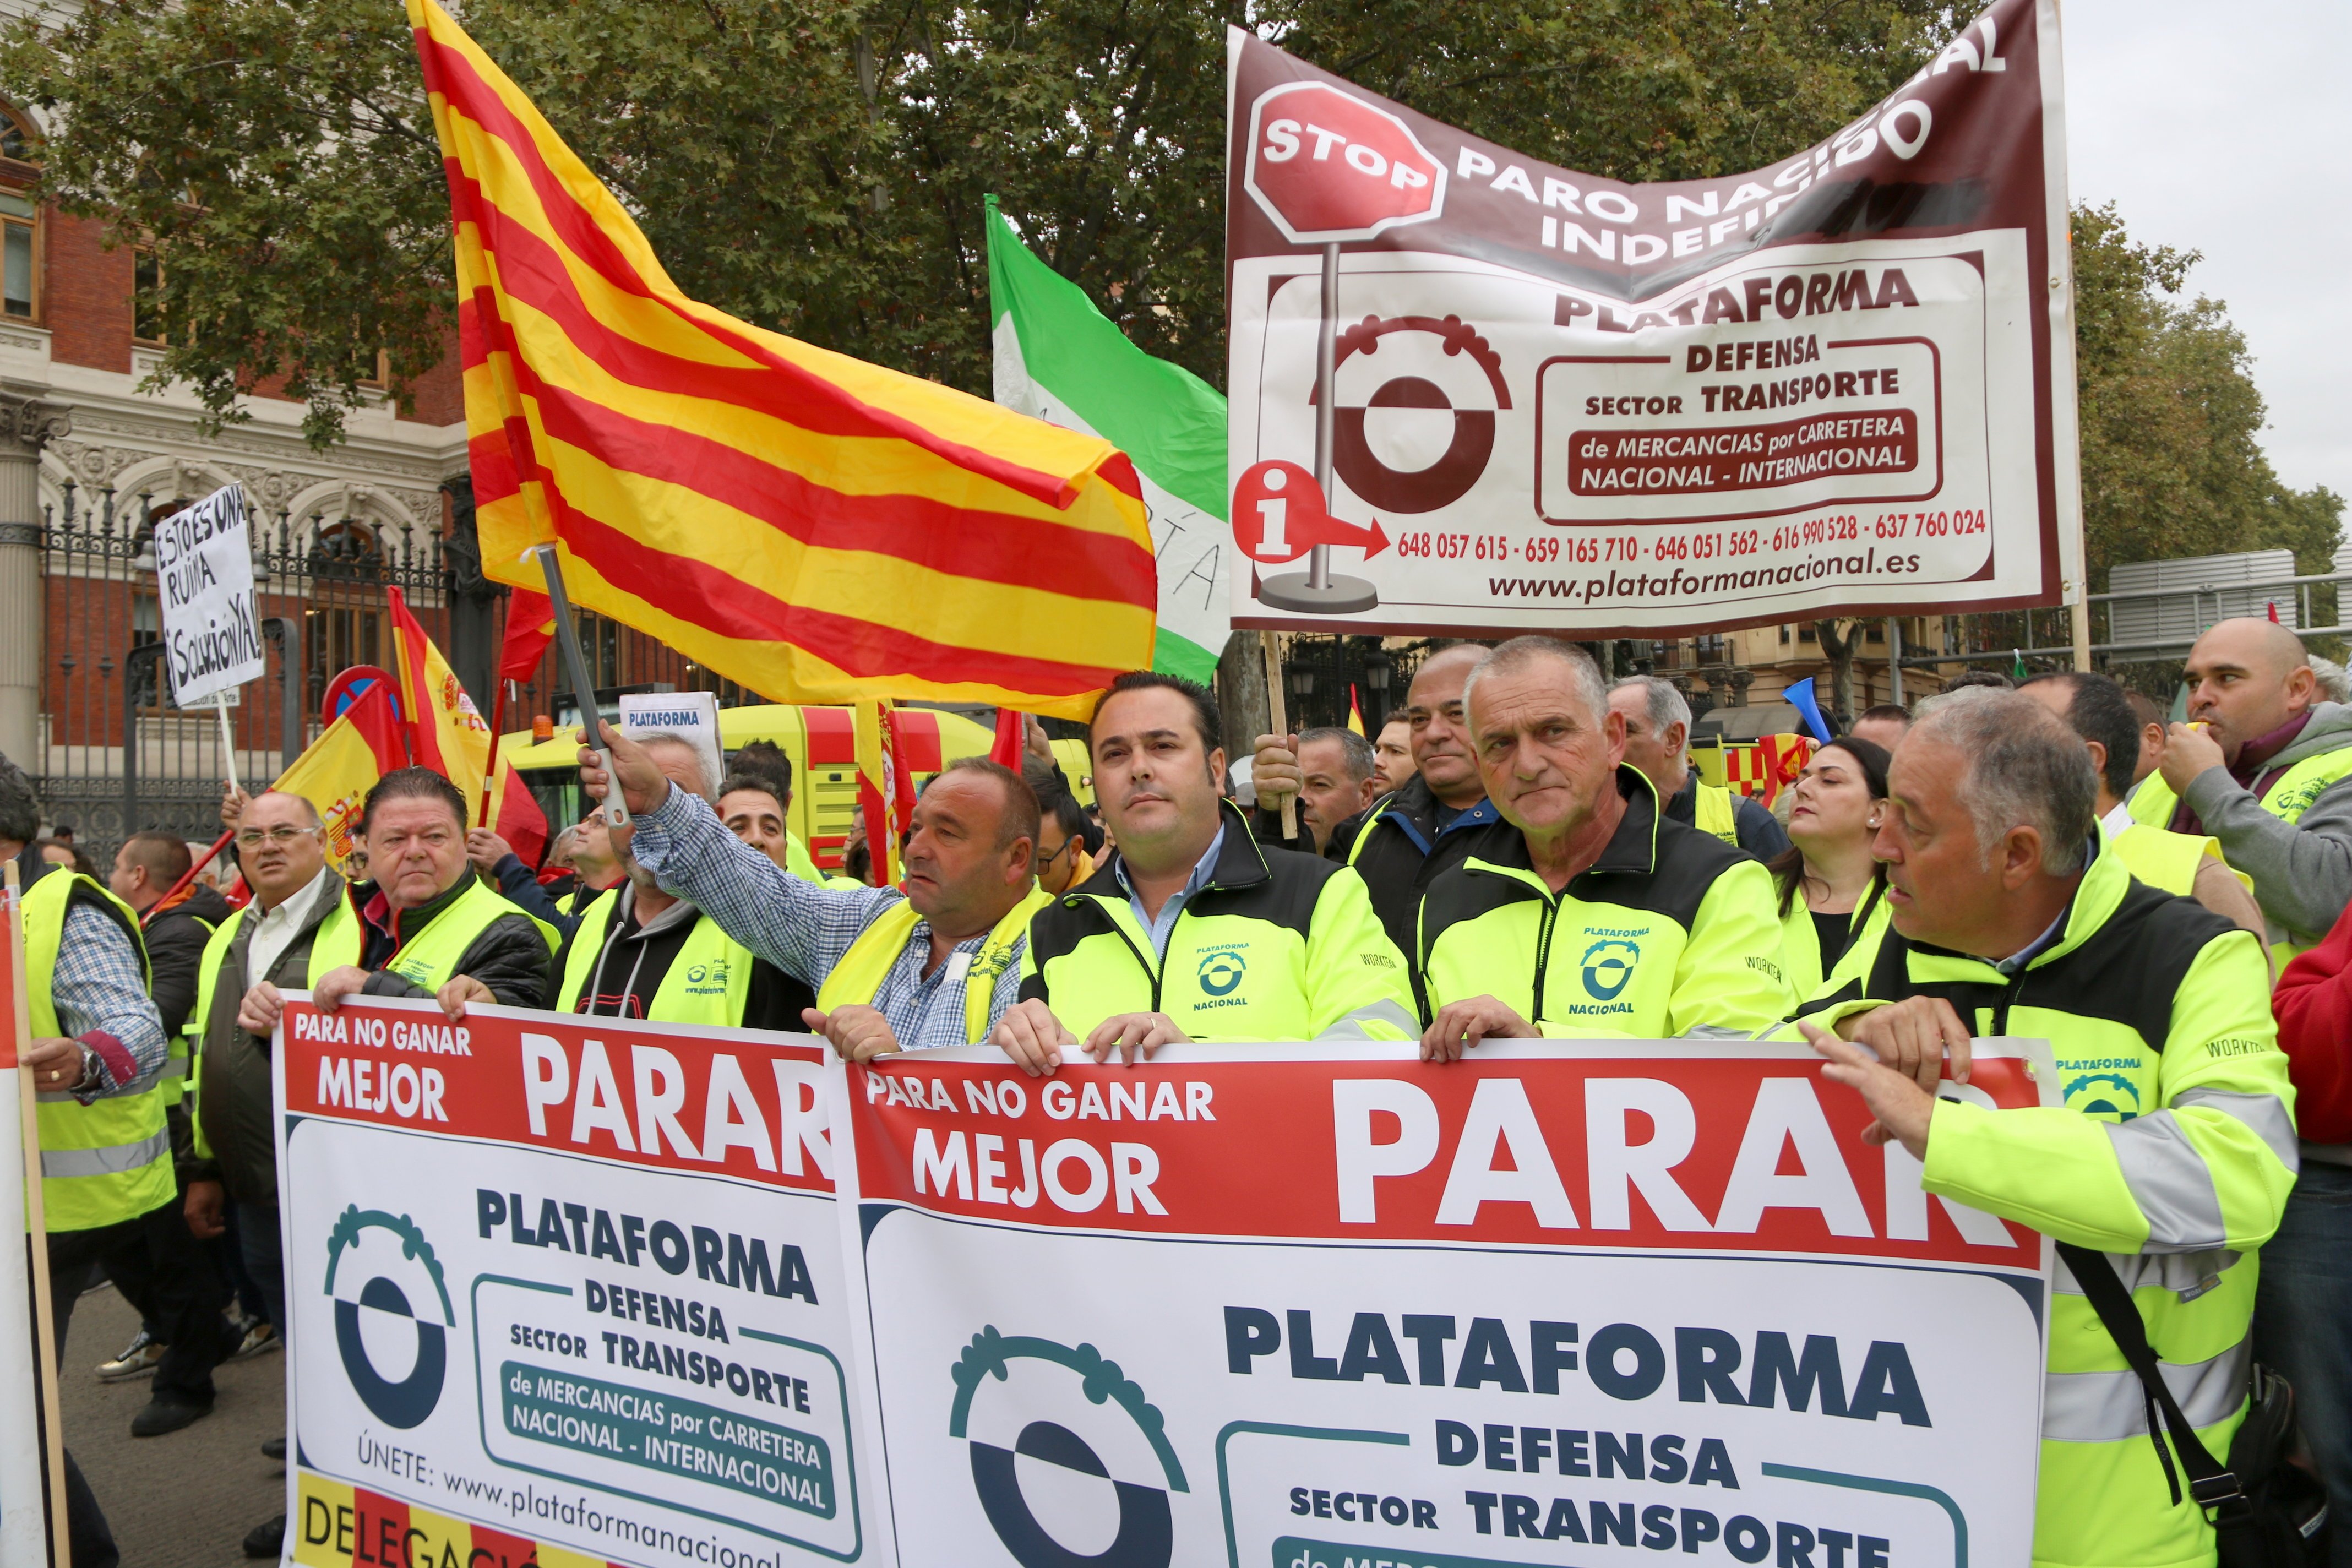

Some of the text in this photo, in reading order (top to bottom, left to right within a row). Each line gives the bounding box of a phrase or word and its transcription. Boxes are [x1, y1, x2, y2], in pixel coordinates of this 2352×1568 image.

[1263, 119, 1428, 190] STOP
[1456, 145, 1638, 223] PARO
[1554, 268, 1919, 333] PLATAFORMA
[1686, 334, 1820, 372] DEFENSA
[1585, 368, 1899, 415] SECTOR TRANSPORTE
[1580, 465, 1714, 488] NACIONAL
[1738, 444, 1907, 484] INTERNACIONAL
[1581, 416, 1905, 458] de MERCANCIAS por CARRETERA
[157, 485, 247, 571] ESTO ES UNA
[1398, 532, 1430, 558] 648
[1436, 533, 1469, 558] 057
[1475, 535, 1507, 560] 615
[1525, 537, 1559, 562] 659
[1567, 537, 1598, 563] 165
[1605, 536, 1637, 562] 710
[1654, 535, 1687, 560] 646
[1693, 532, 1722, 559] 051
[1729, 529, 1757, 556] 562
[1773, 524, 1799, 551] 616
[1803, 518, 1824, 546] 990
[1828, 515, 1858, 540] 528
[1875, 514, 1908, 539] 637
[1915, 511, 1948, 537] 760
[1953, 509, 1986, 535] 024
[1489, 547, 1921, 604] www.plataformanacional.es
[629, 711, 699, 726] PLATAFORMA
[1197, 943, 1249, 954] PLATAFORMA
[1583, 927, 1650, 937] PLATAFORMA
[295, 1013, 472, 1056] PARA NO GANAR
[1194, 998, 1247, 1011] NACIONAL
[1569, 1003, 1634, 1015] NACIONAL
[318, 1055, 449, 1122] MEJOR
[867, 1070, 1217, 1121] PARA NO GANAR
[2056, 1058, 2141, 1070] PLATAFORMA
[521, 1032, 835, 1180] PARAR
[912, 1127, 1169, 1216] MEJOR
[1332, 1077, 2019, 1248] PARAR
[477, 1188, 819, 1305] PLATAFORMA
[585, 1278, 729, 1344] DEFENSA
[510, 1324, 811, 1414] SECTOR TRANSPORTE
[1223, 1305, 1933, 1429] PLATAFORMA
[510, 1370, 821, 1470] de MERCANCIAS por CARRETERA
[358, 1429, 434, 1487] ÚNETE:
[513, 1404, 623, 1453] NACIONAL
[644, 1435, 826, 1510] INTERNACIONAL
[1434, 1419, 1740, 1490] DEFENSA
[305, 1495, 542, 1567] DELEGA
[1289, 1487, 1890, 1567] SECTOR TRANSPORTE
